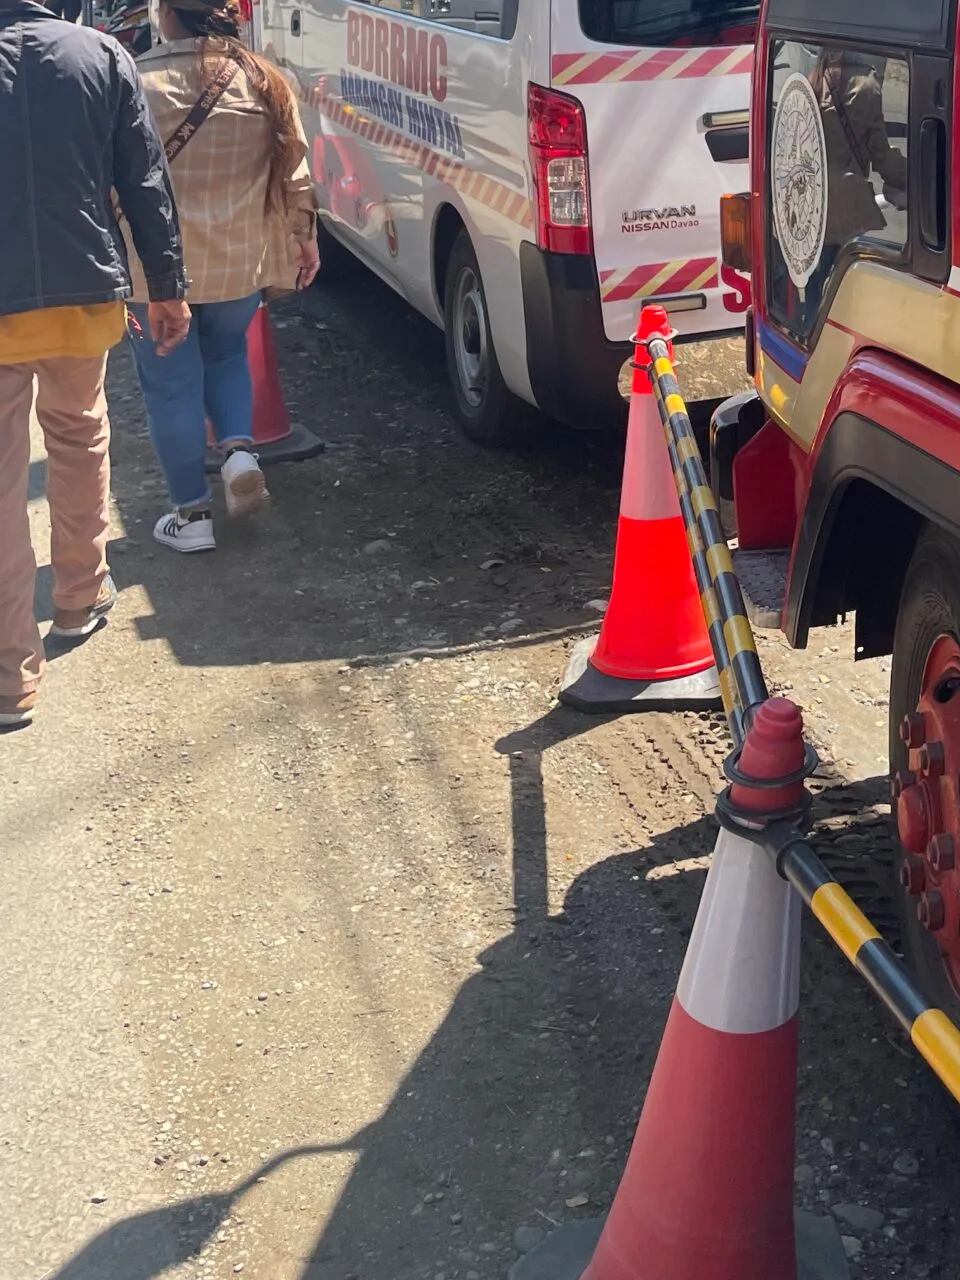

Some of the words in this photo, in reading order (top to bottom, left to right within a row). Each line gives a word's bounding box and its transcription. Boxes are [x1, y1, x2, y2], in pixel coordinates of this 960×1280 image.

[348, 10, 448, 102] BDRRMC
[340, 68, 403, 129] BARANGAY
[405, 95, 466, 160] MINTAL
[622, 205, 696, 222] URVAN
[622, 221, 669, 233] NISSAN
[671, 220, 699, 229] Davao
